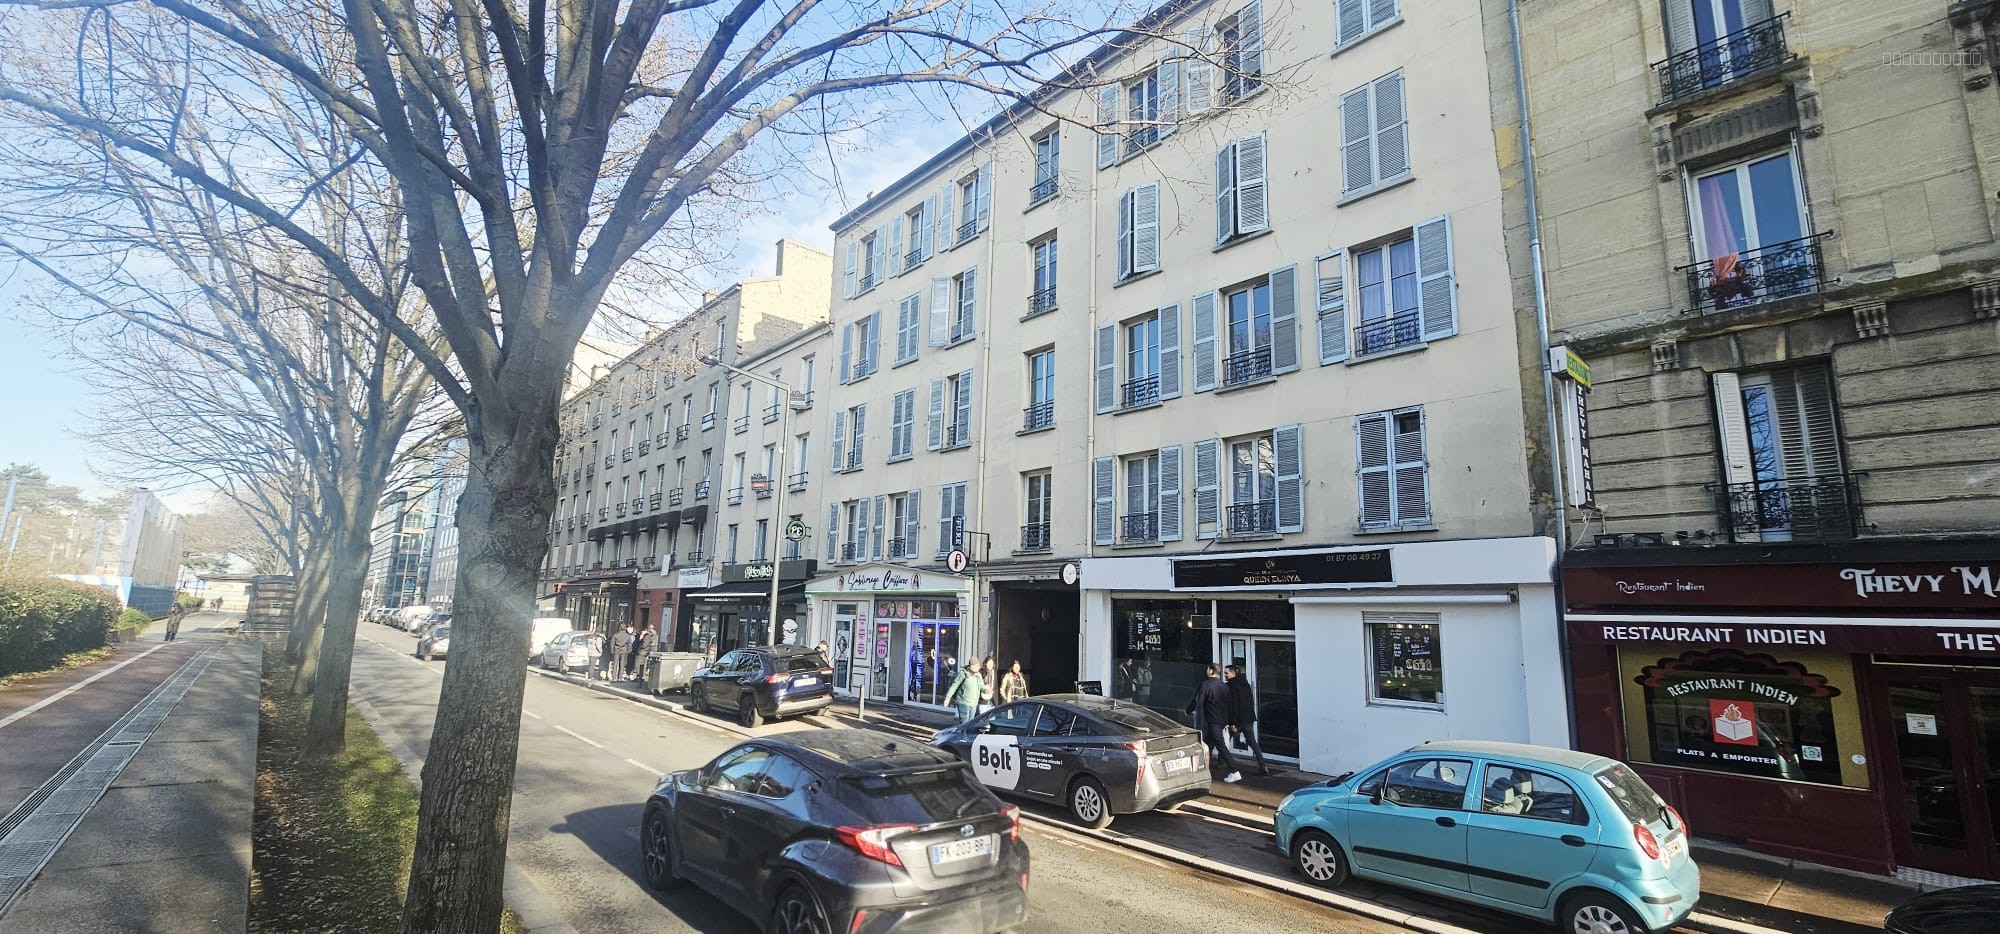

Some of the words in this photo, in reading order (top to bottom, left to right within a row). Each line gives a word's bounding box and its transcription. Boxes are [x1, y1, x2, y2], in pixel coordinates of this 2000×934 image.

[1576, 385, 1587, 439] THEVY
[1581, 446, 1593, 502] MAHAL
[1335, 554, 1346, 562] 87
[1359, 553, 1370, 561] 49
[1371, 552, 1382, 560] 27
[1616, 580, 1673, 594] Restaurant
[1676, 579, 1705, 592] Indien
[1840, 567, 1945, 598] THEVY
[1603, 626, 1733, 643] RESTAURANT
[1746, 628, 1826, 646] INDIEN
[1667, 678, 1745, 697] RESTAURANT
[1750, 682, 1799, 706] INDIEN
[979, 745, 1011, 775] Bolt
[1677, 748, 1705, 757] PLATS
[1723, 753, 1778, 765] EMPORTER
